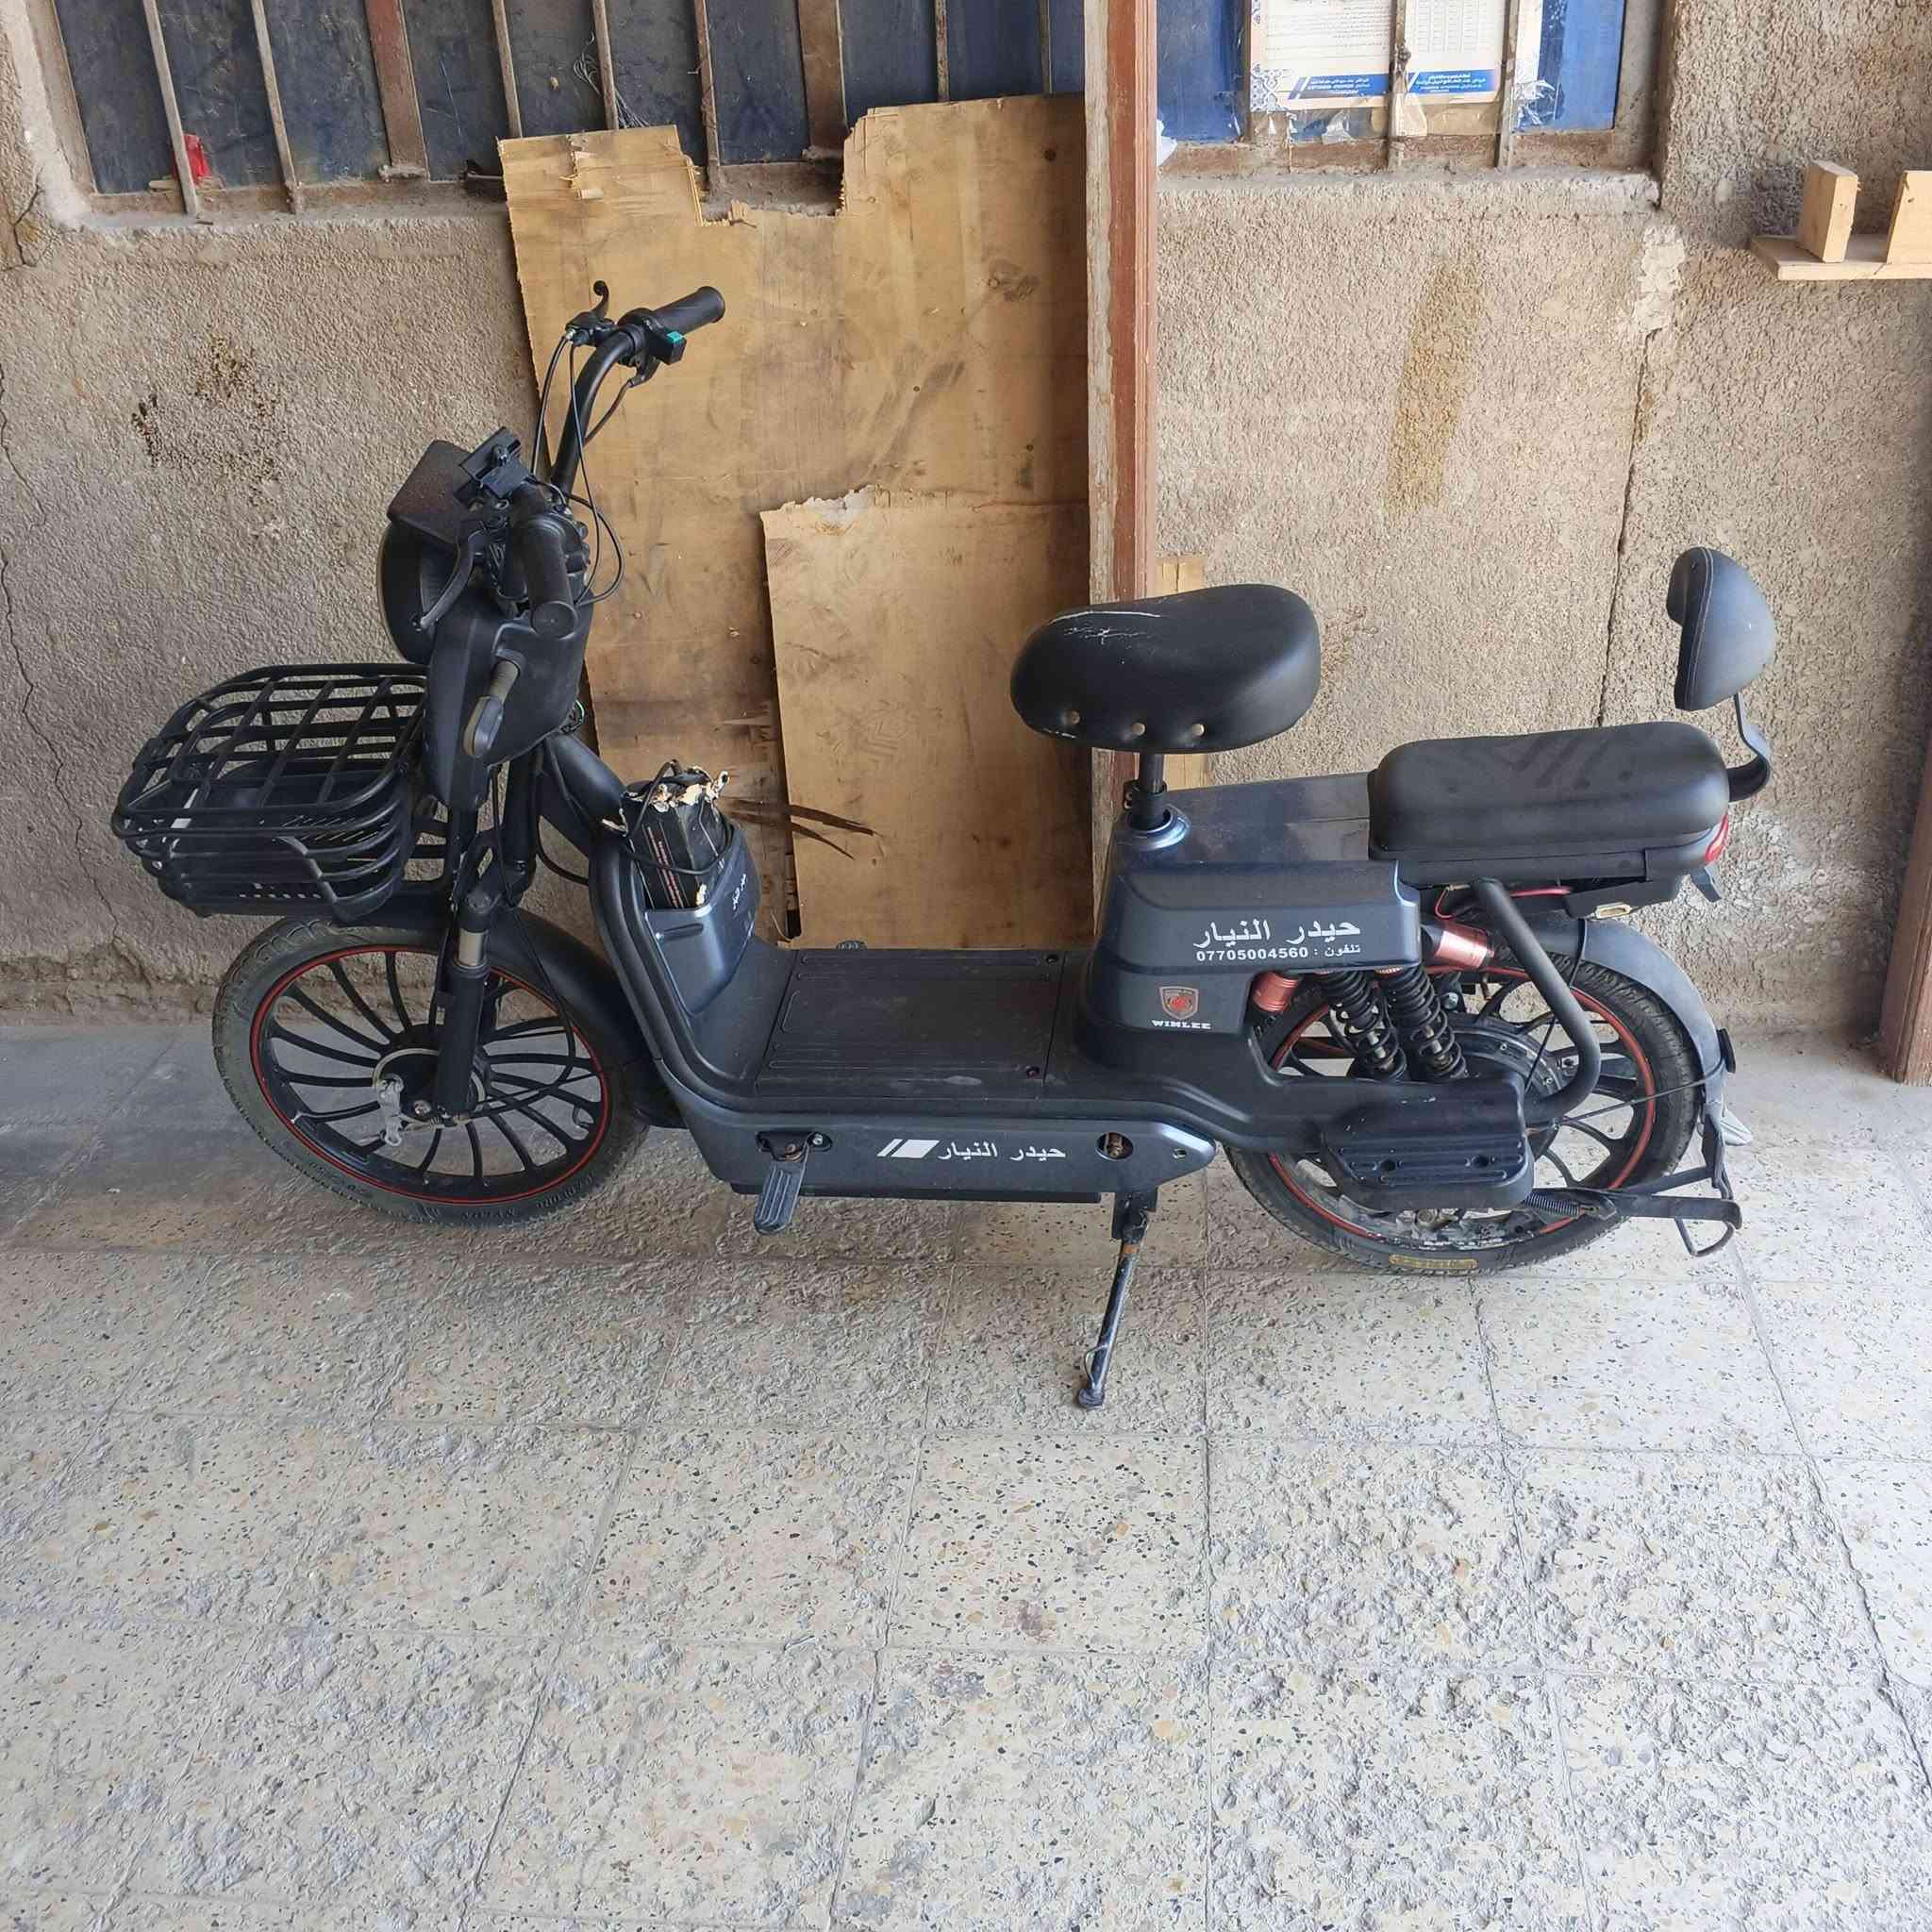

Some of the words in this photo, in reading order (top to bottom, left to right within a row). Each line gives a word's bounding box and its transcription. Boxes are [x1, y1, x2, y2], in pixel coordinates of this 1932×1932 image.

[1286, 920, 1361, 945] حيدر
[1195, 946, 1309, 962] 07705004560
[1009, 1145, 1066, 1162] حيدر
